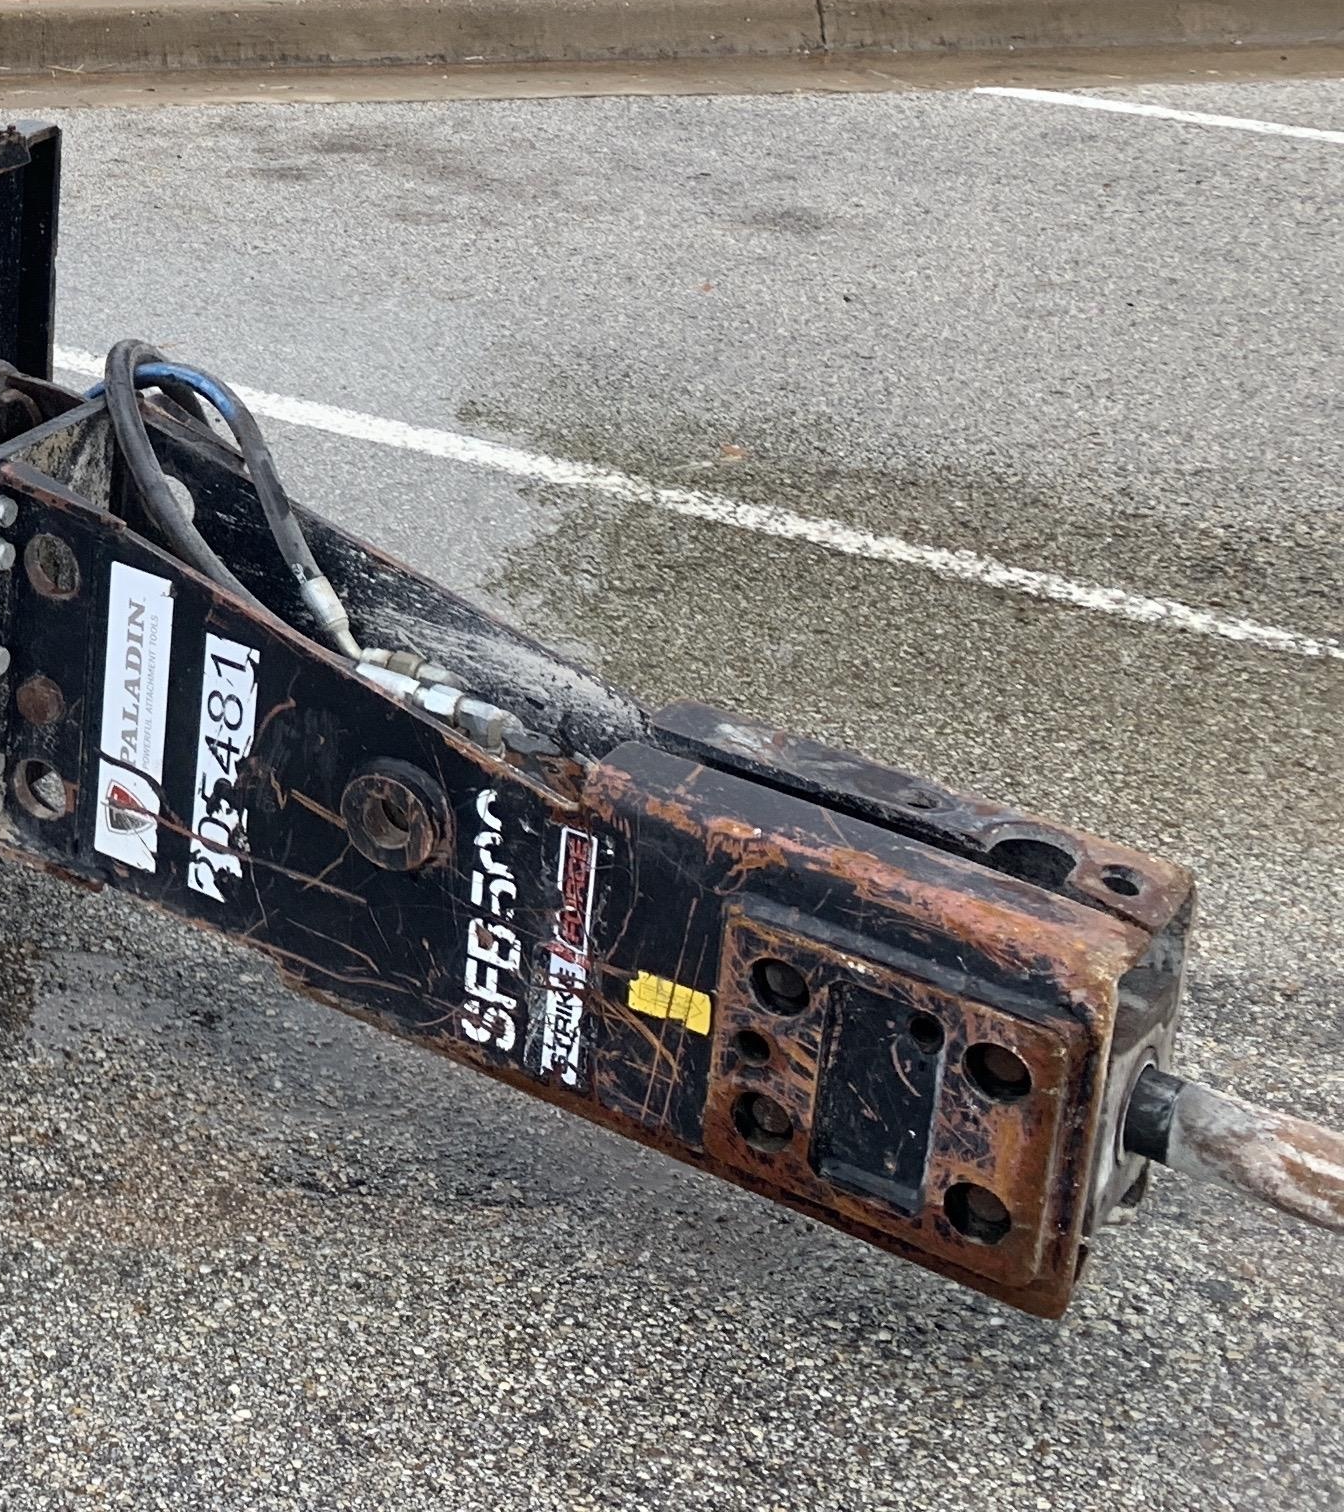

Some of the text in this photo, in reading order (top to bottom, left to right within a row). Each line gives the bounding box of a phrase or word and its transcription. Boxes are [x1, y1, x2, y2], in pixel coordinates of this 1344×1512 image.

[119, 598, 147, 767] PALADIN
[142, 615, 160, 770] POWERFUL ATTACHMENT TOOLS
